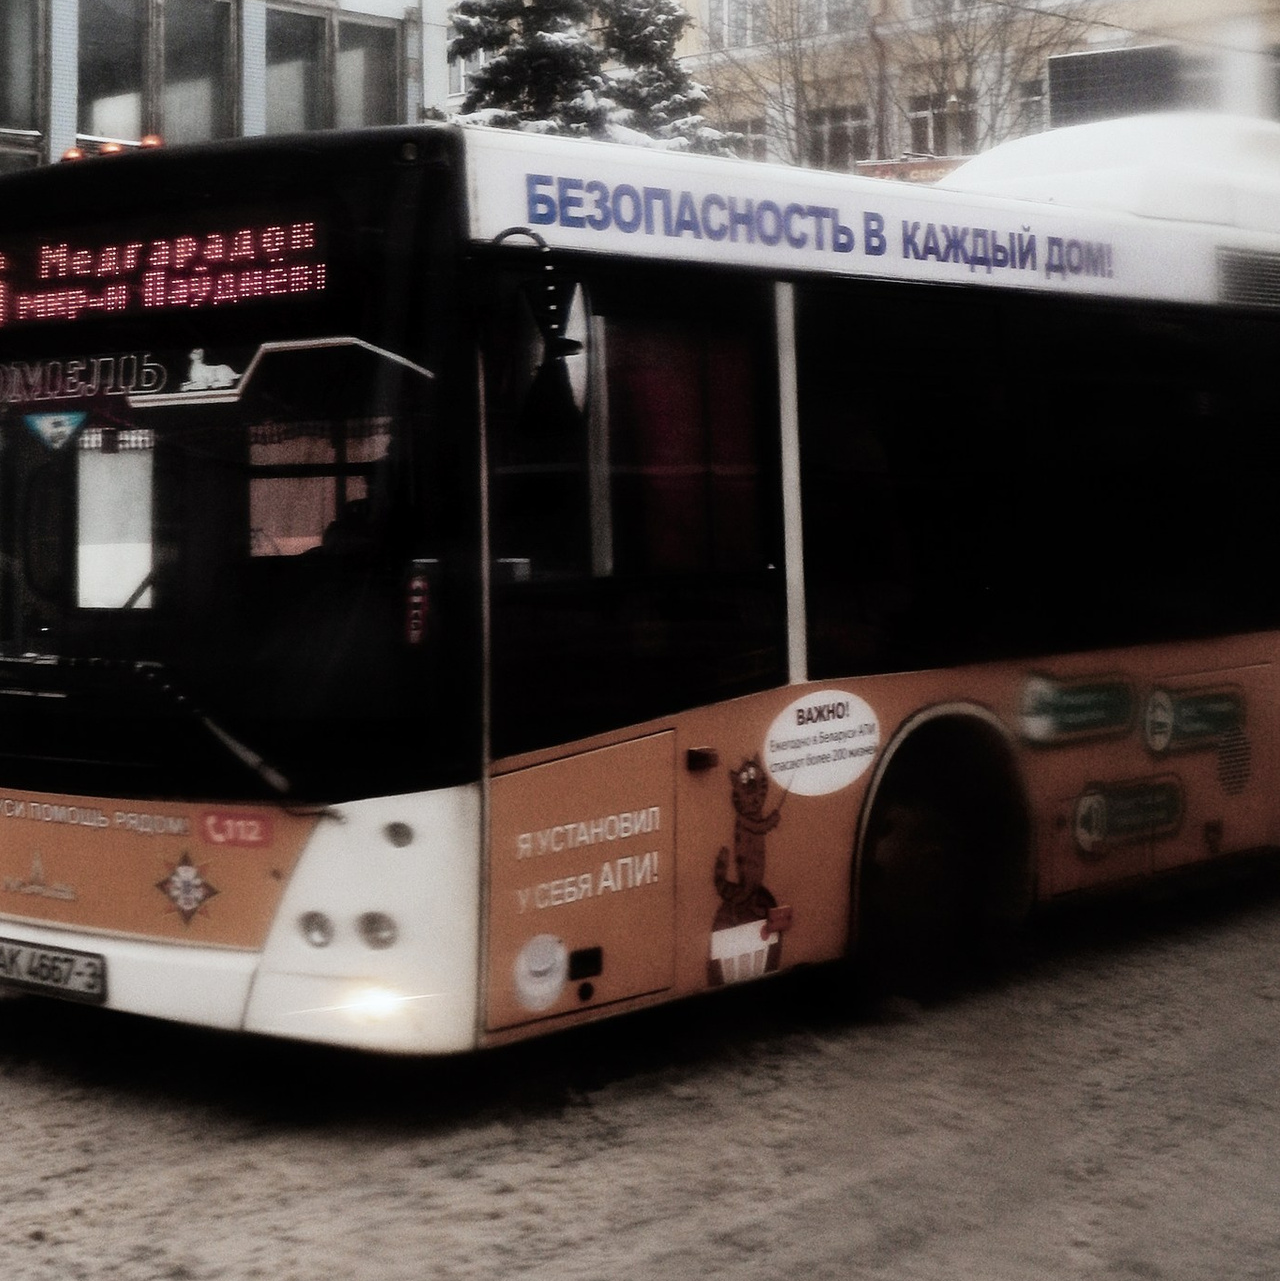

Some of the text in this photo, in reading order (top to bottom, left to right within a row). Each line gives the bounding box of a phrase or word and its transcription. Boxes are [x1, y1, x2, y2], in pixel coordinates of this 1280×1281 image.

[526, 173, 1113, 280] БЕЗОПАСНОСТЬ В КАЖДЫЙ ДОМ!
[40, 221, 315, 278] Медгарадок
[19, 284, 127, 320] мкр-н
[796, 701, 850, 726] ВАЖНО!
[819, 729, 857, 745] Беларуси
[28, 801, 109, 829] ПОМОЩЬ
[517, 805, 660, 860] Я УСТАНОВИЛ
[516, 851, 659, 915] У СЕБЯ АПИ!
